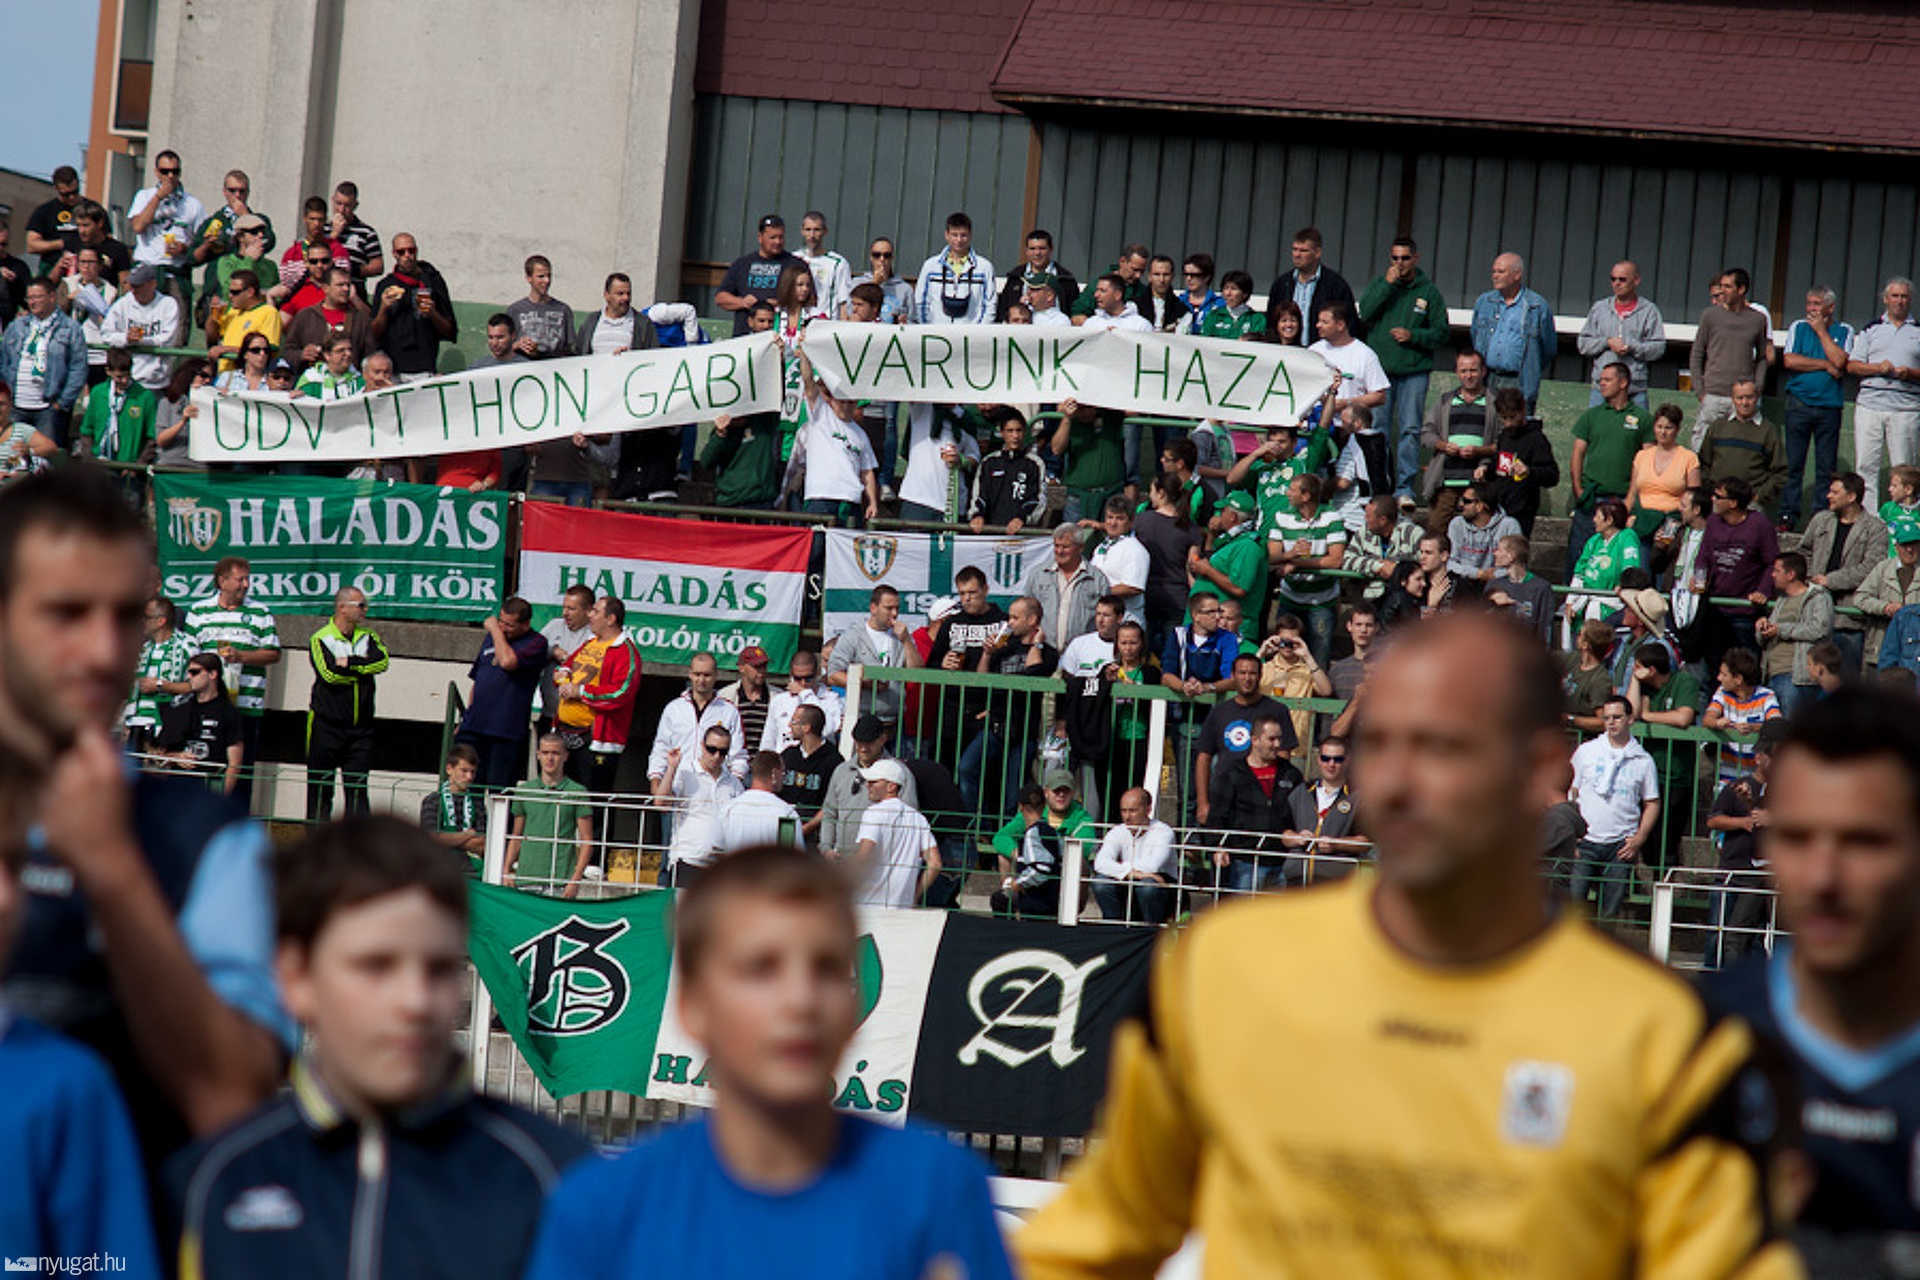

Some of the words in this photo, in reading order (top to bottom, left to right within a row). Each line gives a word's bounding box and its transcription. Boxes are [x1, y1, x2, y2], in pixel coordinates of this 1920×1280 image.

[363, 367, 589, 449] ITTHON
[622, 347, 758, 418] GABI
[1133, 343, 1296, 415] HAZA
[226, 485, 501, 551] HALADÁS
[163, 566, 396, 599] SZRKOLÓI
[410, 568, 498, 602] KÖR
[557, 564, 768, 612] HALADÁS
